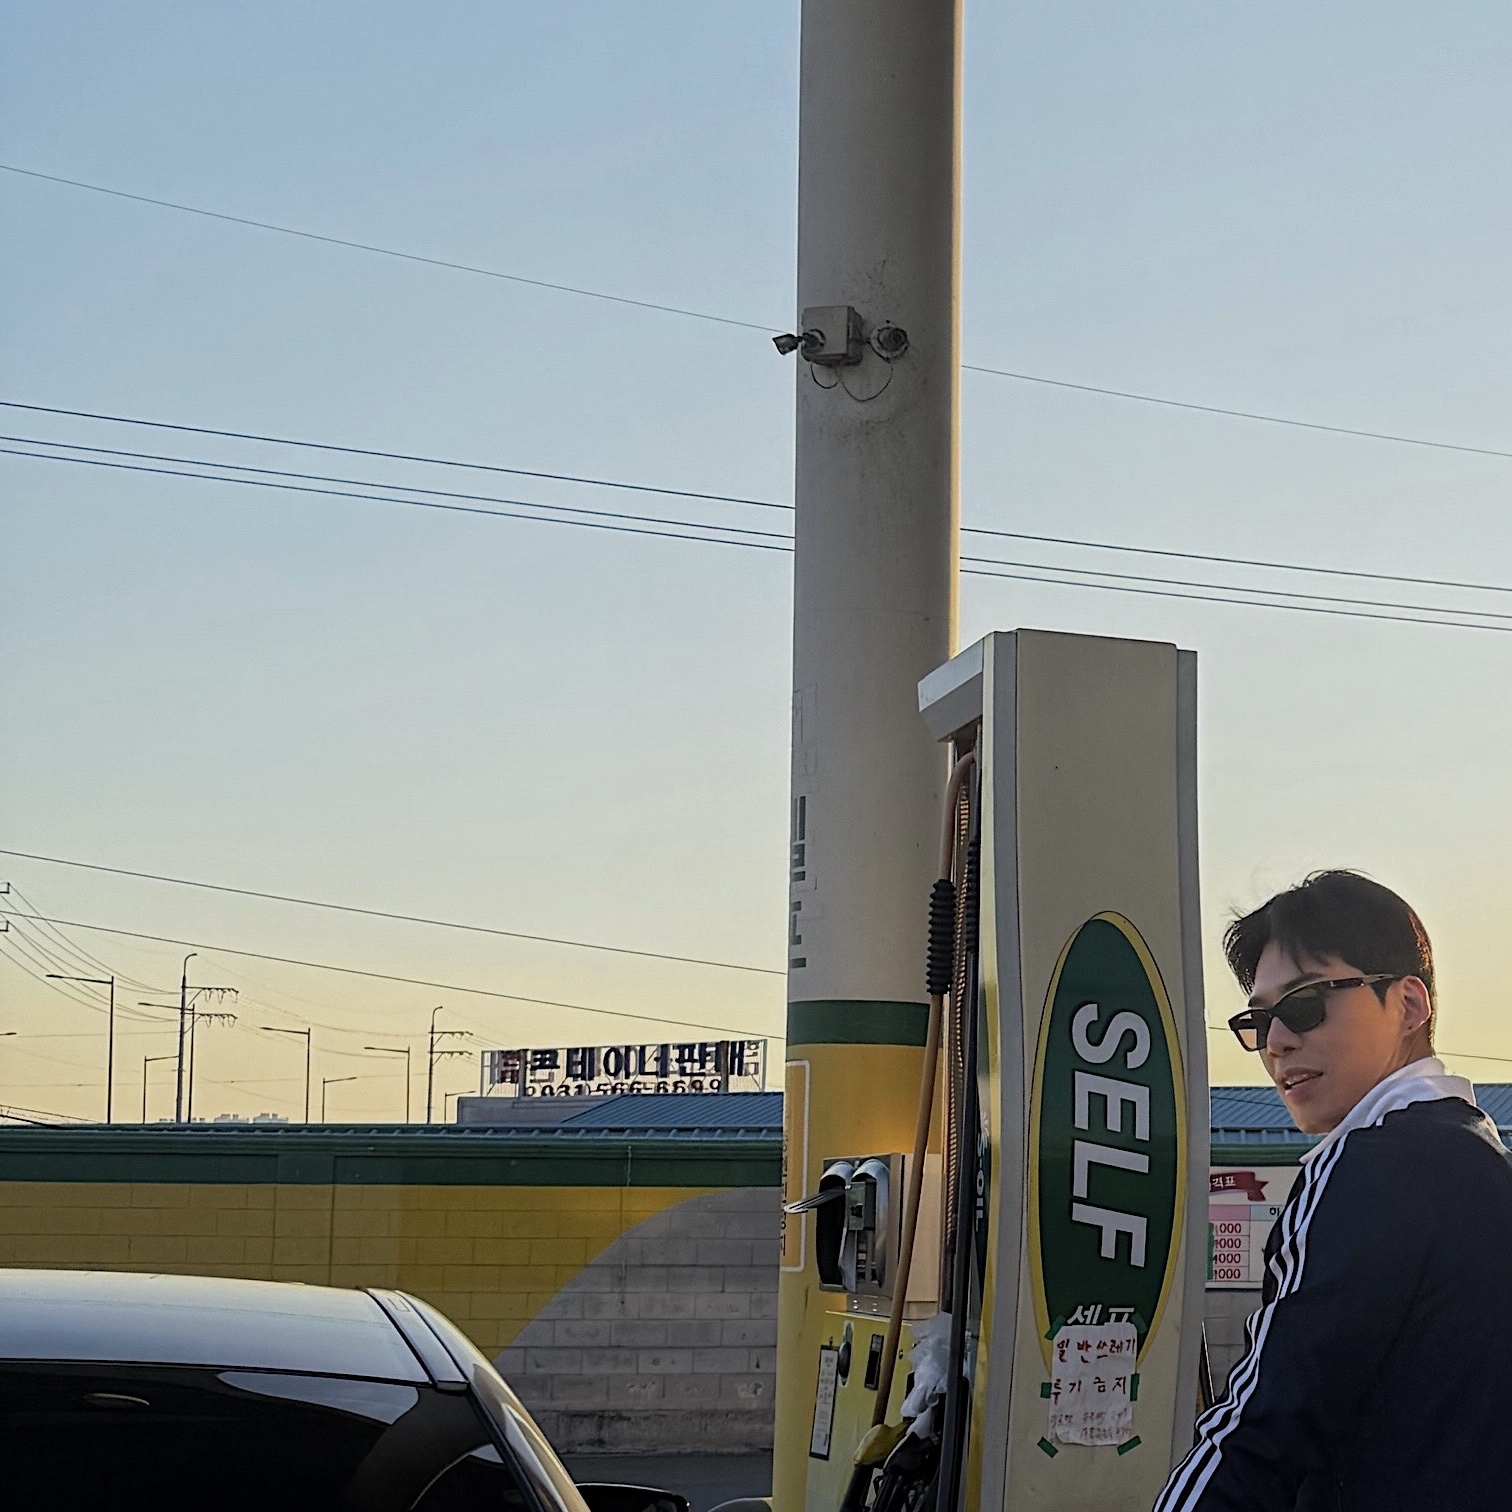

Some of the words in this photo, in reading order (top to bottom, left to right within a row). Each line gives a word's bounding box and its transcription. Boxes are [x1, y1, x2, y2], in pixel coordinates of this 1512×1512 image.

[1071, 1003, 1151, 1268] SELF
[975, 1131, 985, 1233] S-OIL
[1211, 1175, 1236, 1188] 격표
[1094, 1376, 1126, 1395] 금지
